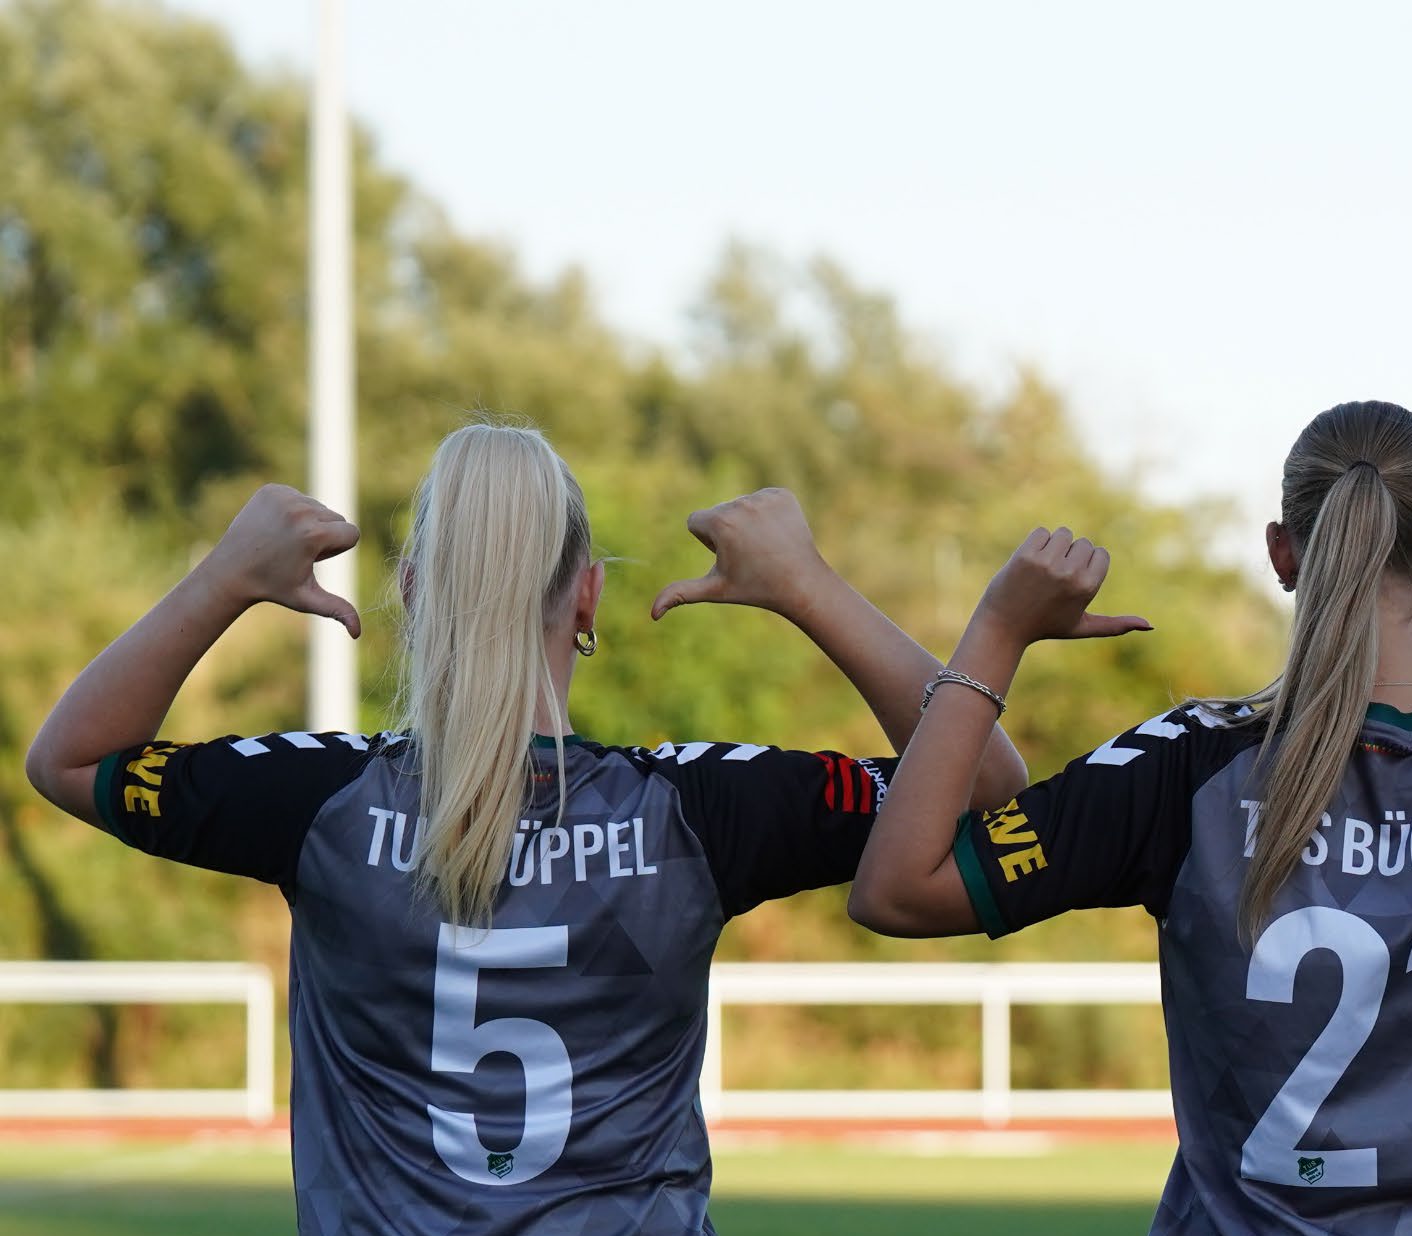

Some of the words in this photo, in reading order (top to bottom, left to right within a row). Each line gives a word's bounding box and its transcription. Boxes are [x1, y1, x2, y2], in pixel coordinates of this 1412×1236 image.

[367, 806, 428, 872] TU
[508, 817, 658, 887] ÜPPEL
[982, 798, 1049, 883] WE
[1240, 799, 1332, 866] TS
[427, 922, 573, 1186] 5
